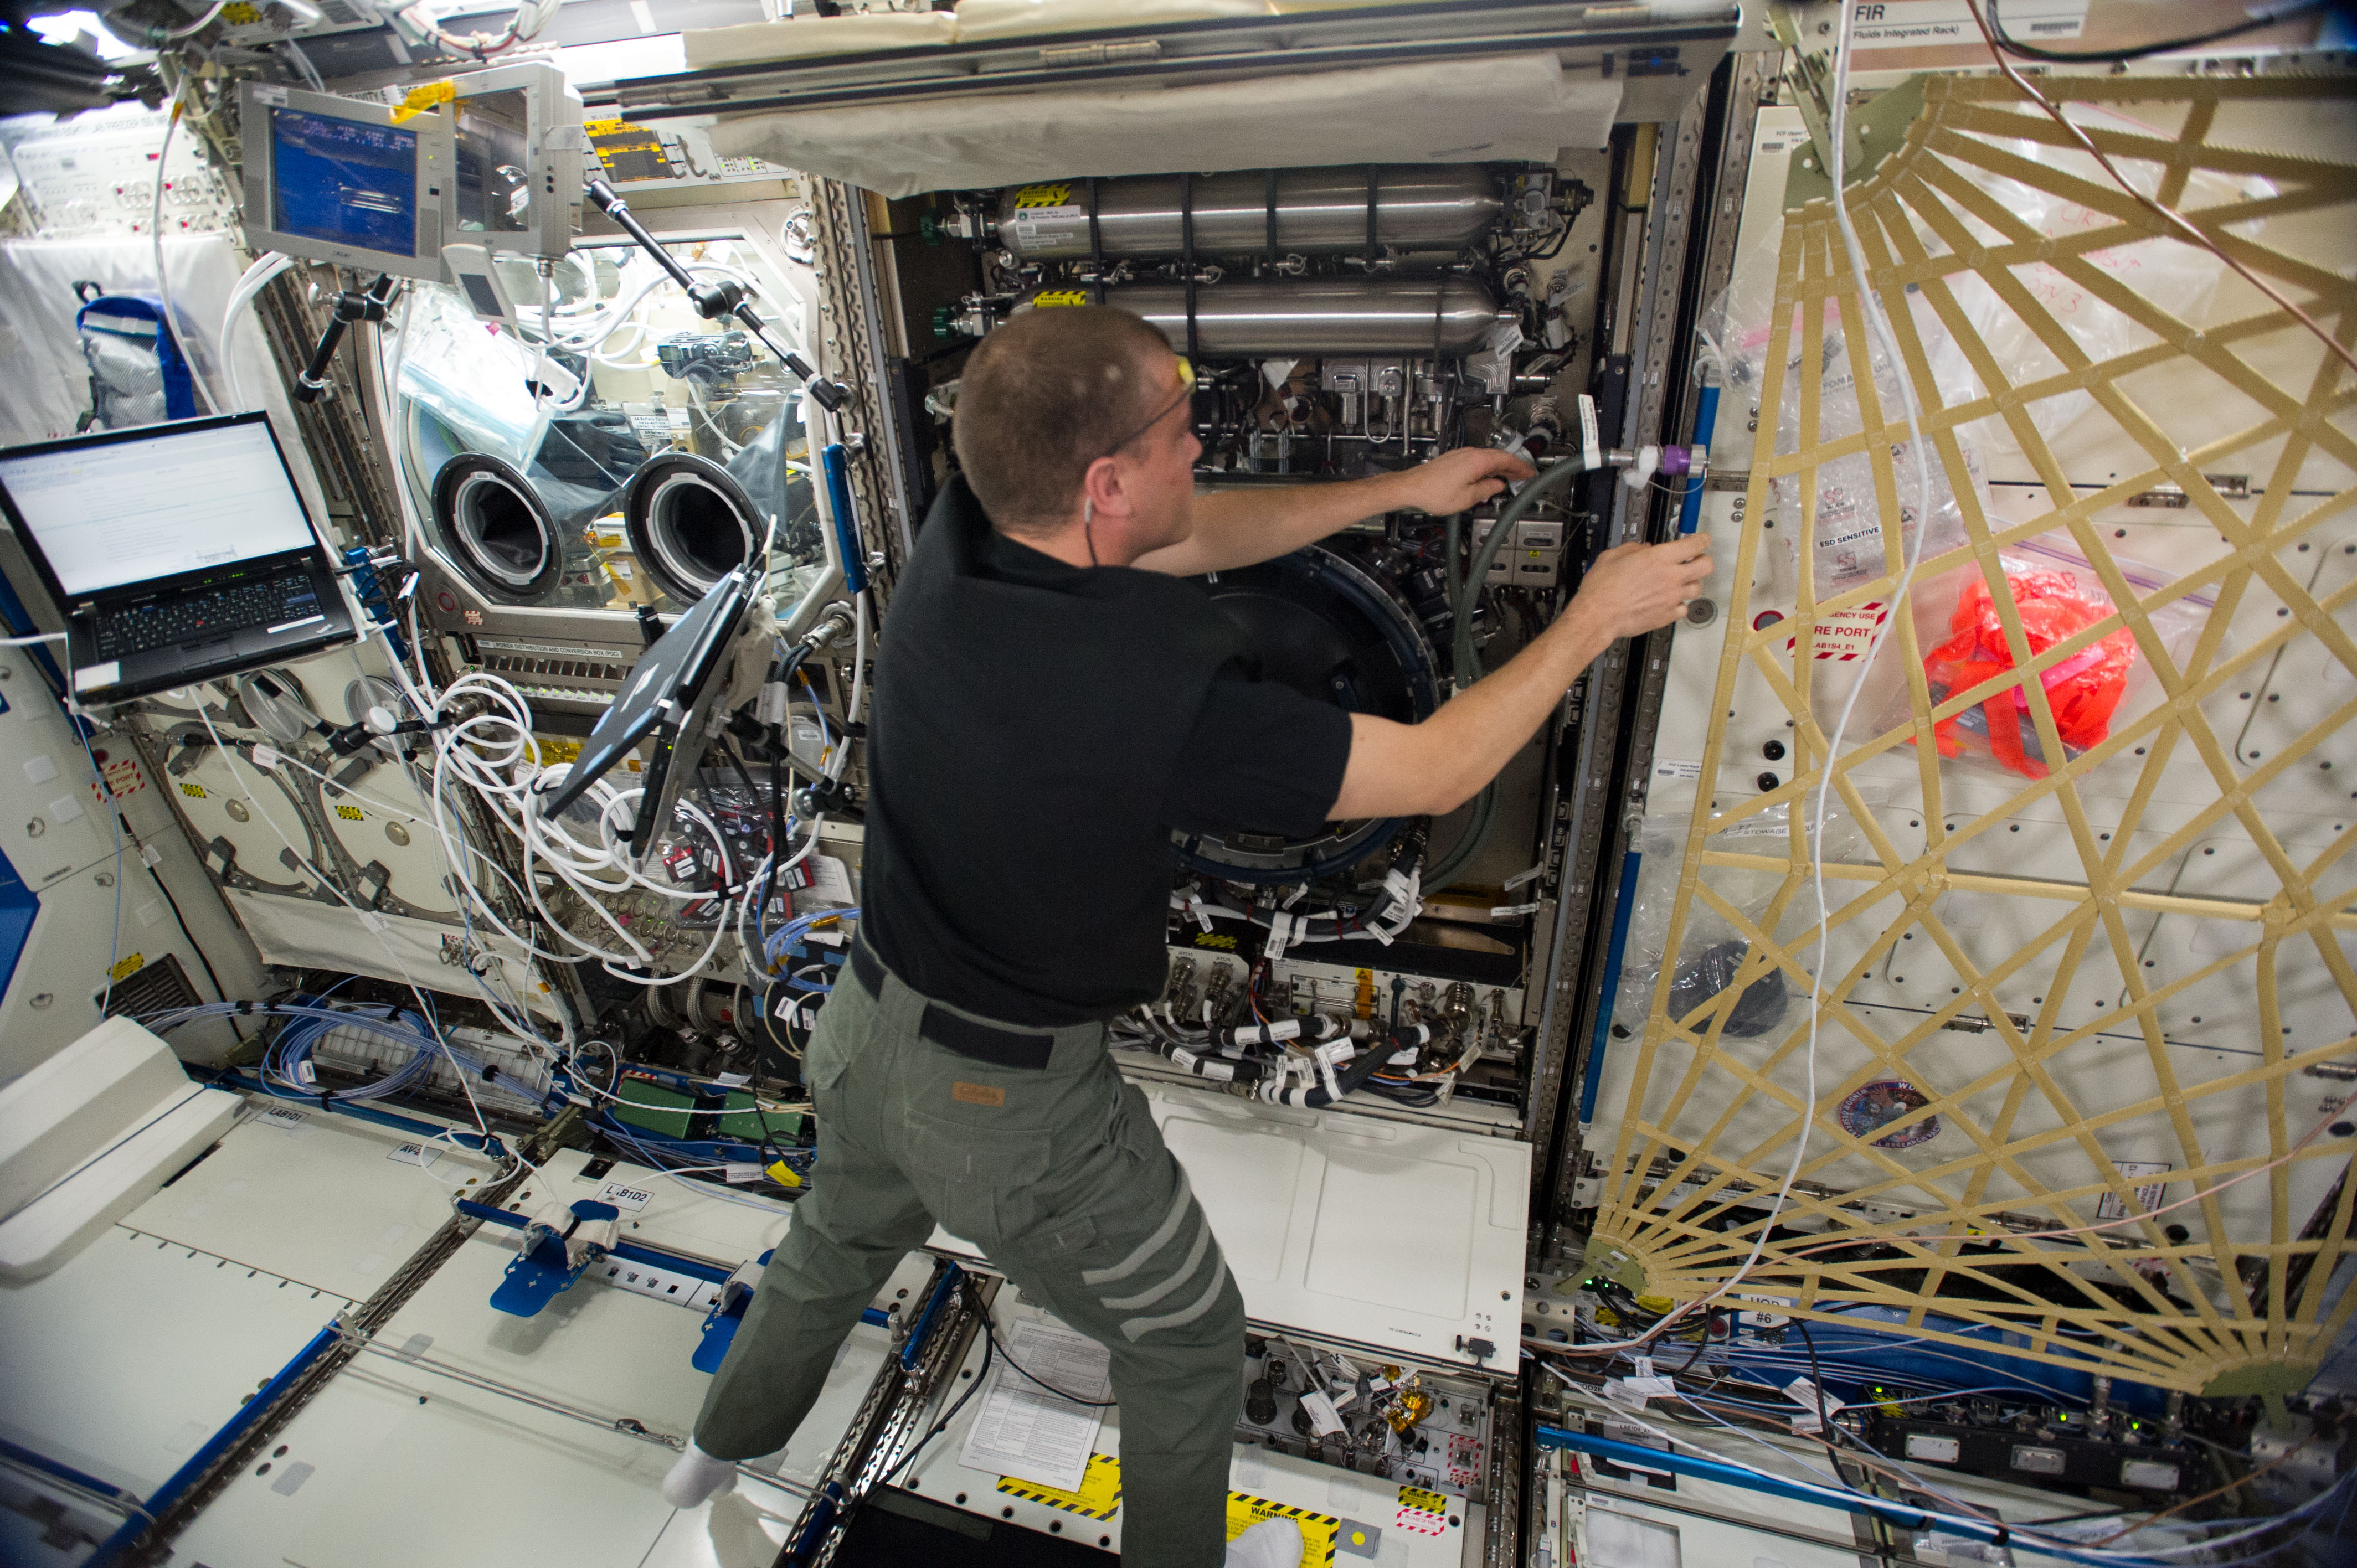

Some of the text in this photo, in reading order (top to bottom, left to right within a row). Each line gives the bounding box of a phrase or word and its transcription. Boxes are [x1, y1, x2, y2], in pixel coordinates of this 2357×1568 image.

[1855, 4, 1885, 21] FIR
[1883, 27, 1931, 39] Integrated
[1933, 25, 1960, 35] Rack)
[1820, 526, 1880, 548] ESD SENSITIVE
[1835, 627, 1871, 638] PORT
[515, 643, 548, 652] DISTRIBUTION
[560, 647, 593, 656] CONVERSION
[268, 1107, 301, 1122] LAB1D1
[1756, 1311, 1772, 1324] #6
[1407, 1491, 1427, 1499] WARNING
